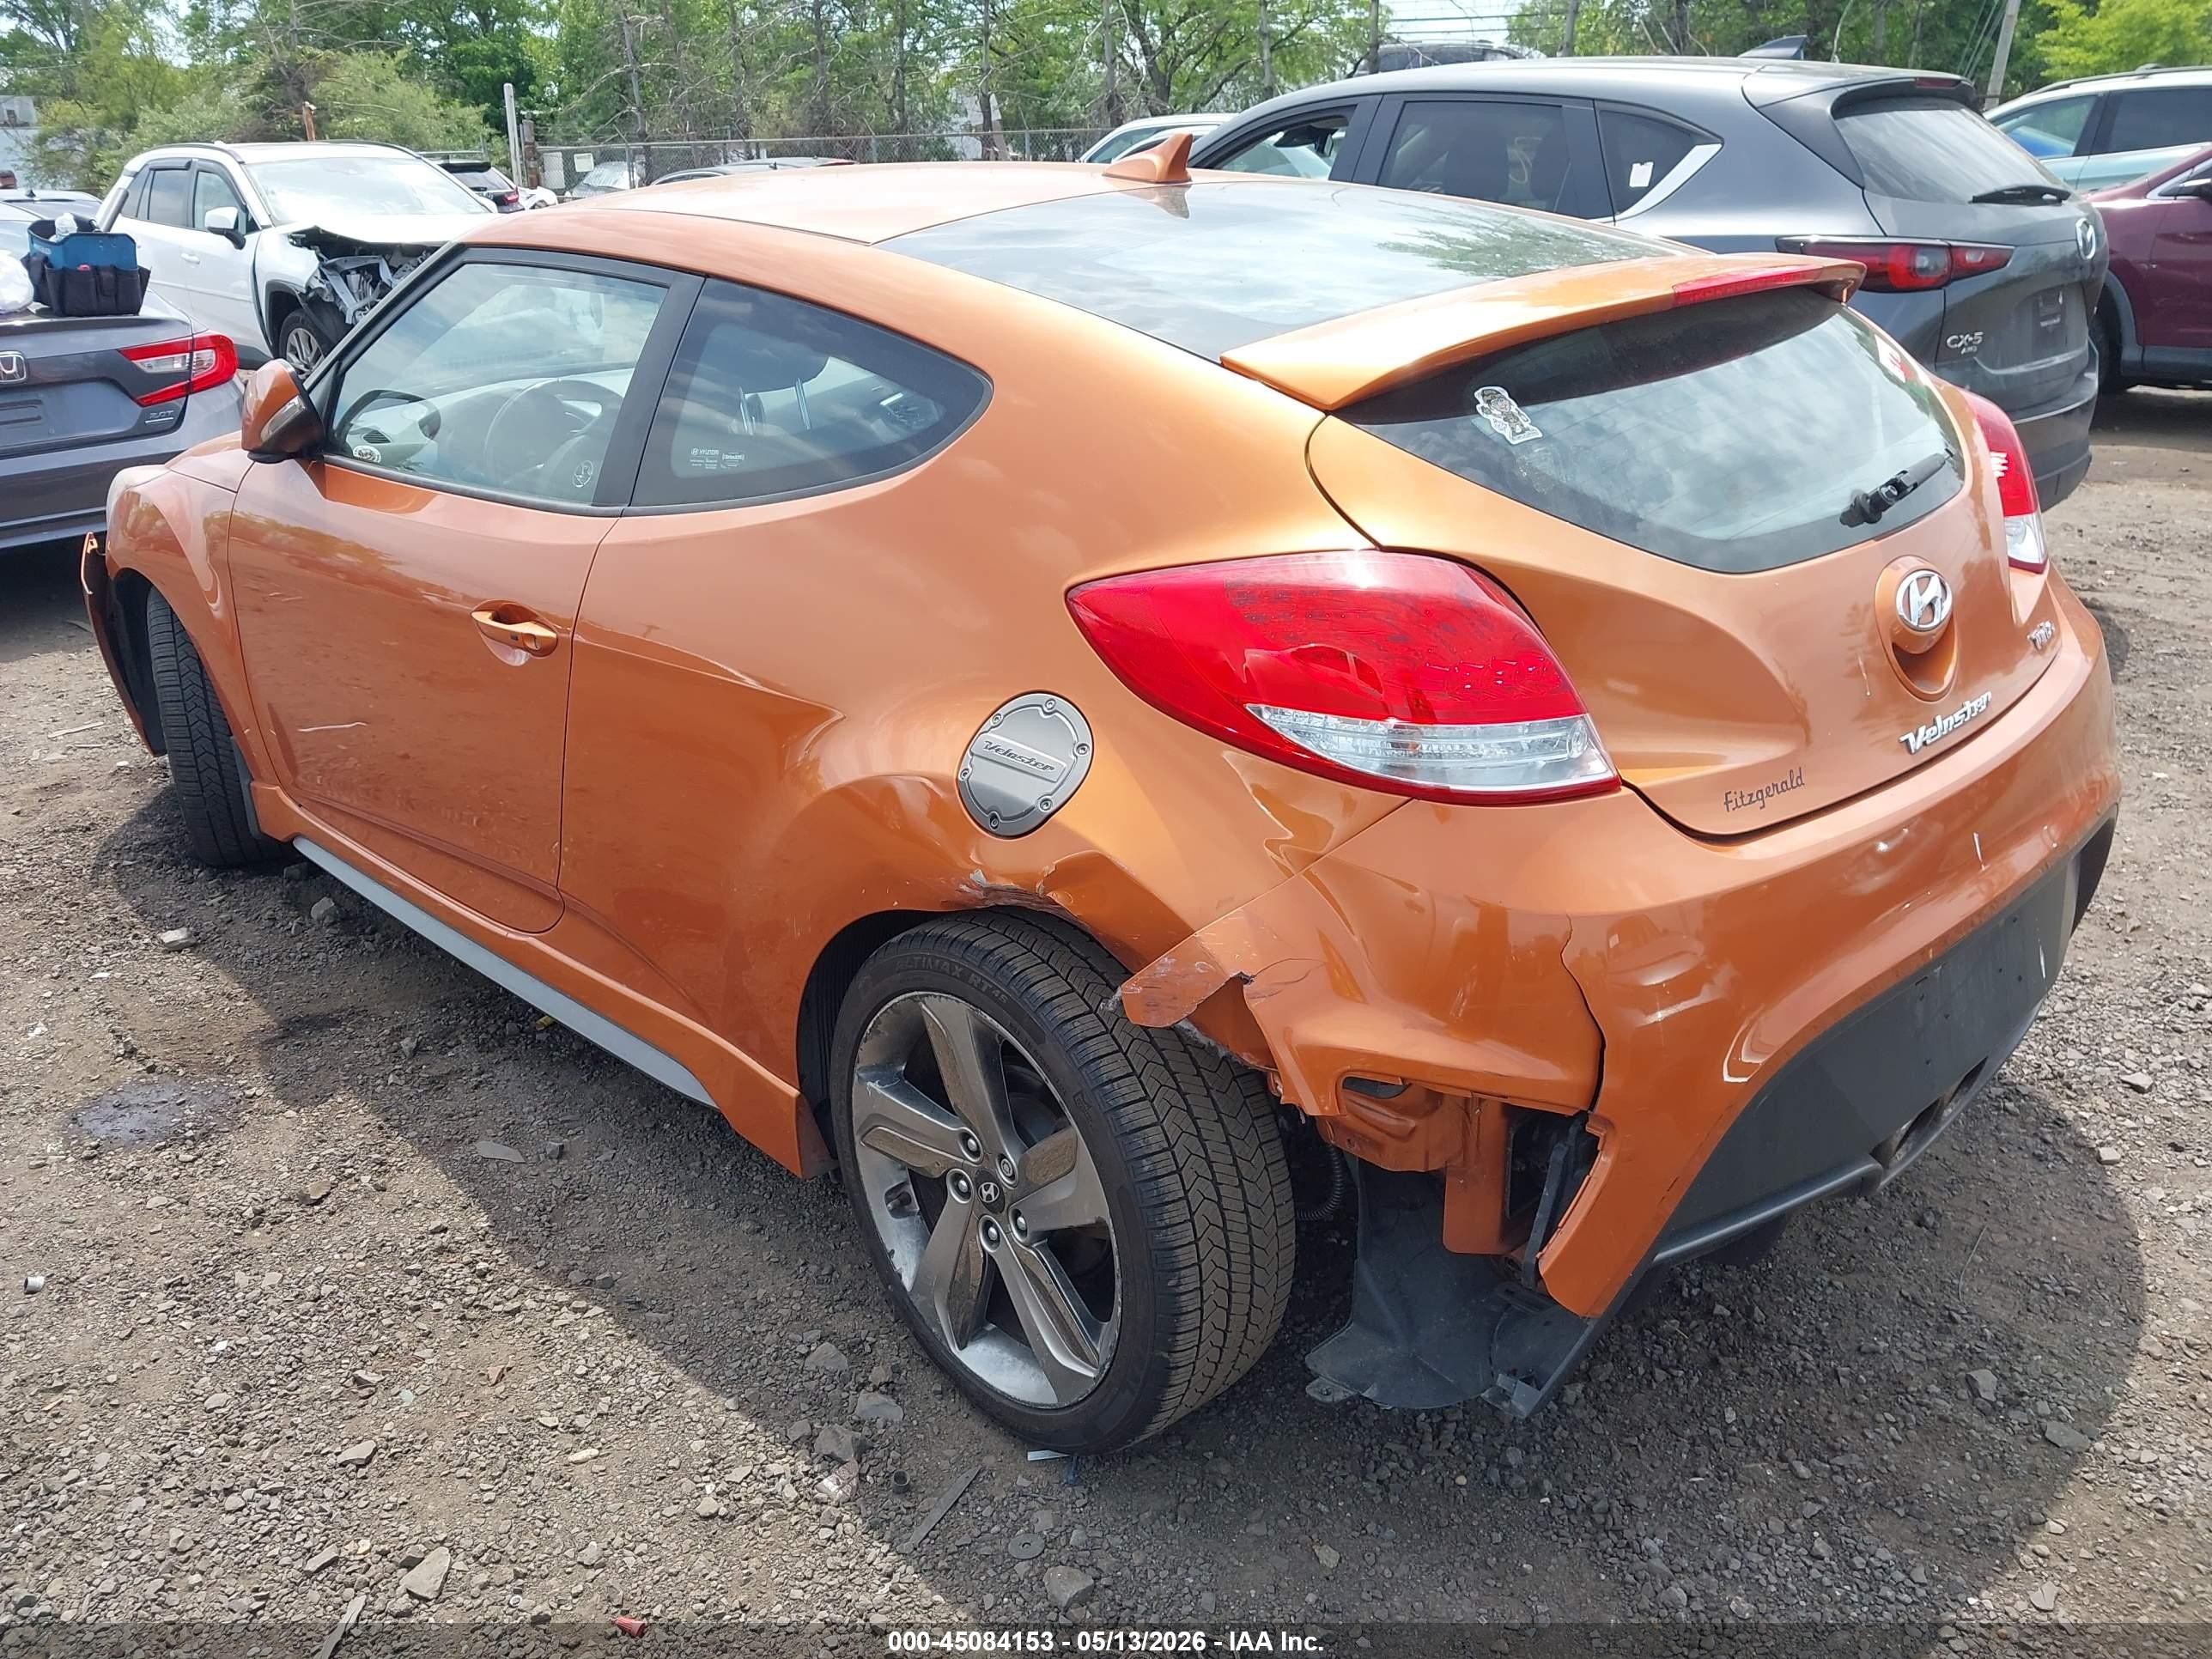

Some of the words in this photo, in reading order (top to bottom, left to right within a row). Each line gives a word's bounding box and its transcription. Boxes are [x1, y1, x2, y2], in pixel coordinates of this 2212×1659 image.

[1946, 331, 1984, 349] CX-5
[1899, 691, 1992, 754] Veloster
[983, 740, 1055, 772] Veloster
[1723, 767, 1805, 812] Fitzgerald
